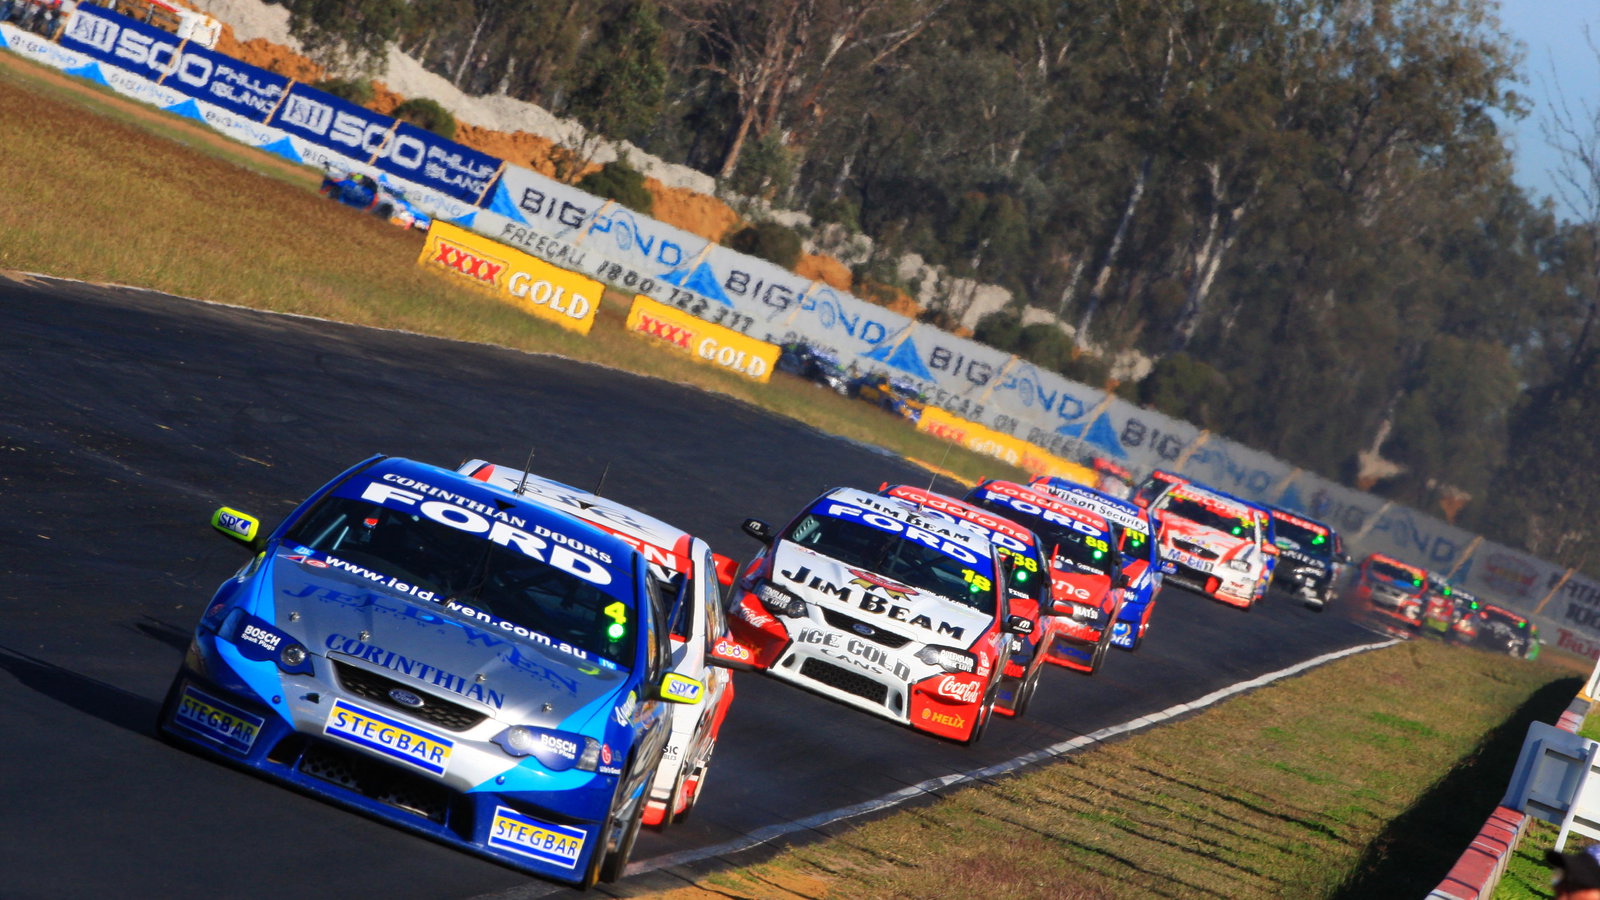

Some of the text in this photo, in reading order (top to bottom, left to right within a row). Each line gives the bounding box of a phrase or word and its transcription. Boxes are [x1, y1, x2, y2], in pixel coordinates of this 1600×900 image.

[115, 27, 213, 88] 500
[209, 81, 280, 114] ISLAND
[215, 64, 283, 98] PHILLIP
[329, 109, 425, 170] 500
[424, 160, 490, 195] ISLAND
[501, 222, 588, 267] FREECALL
[433, 241, 592, 320] XXXX GOLD
[636, 314, 694, 349] XXXX
[697, 337, 767, 379] GOLD
[382, 473, 613, 565] CORINTHIAN DOORS
[855, 494, 970, 543] JIM BEAM
[895, 489, 1030, 542] vodafone
[985, 490, 1102, 537] FORD
[991, 484, 1105, 528] vodafone
[1047, 486, 1148, 532] Wilson Security
[360, 481, 613, 586] FORD
[827, 503, 978, 565] FORD
[1084, 535, 1109, 553] 88
[780, 565, 851, 603] JIM
[858, 590, 967, 641] BEAM
[960, 568, 993, 592] 18
[243, 624, 282, 647] BOSCH
[603, 600, 627, 625] 4
[324, 632, 506, 710] CORINTHIAN
[717, 641, 749, 660] dodo
[797, 626, 844, 648] ICE
[846, 637, 911, 682] COLD
[820, 647, 883, 675] CANS
[178, 698, 255, 745] STEGBAR
[334, 711, 445, 764] STEGBAR
[931, 711, 965, 729] HELIX
[540, 733, 577, 754] BOSCH
[496, 819, 579, 857] STEGBAR
